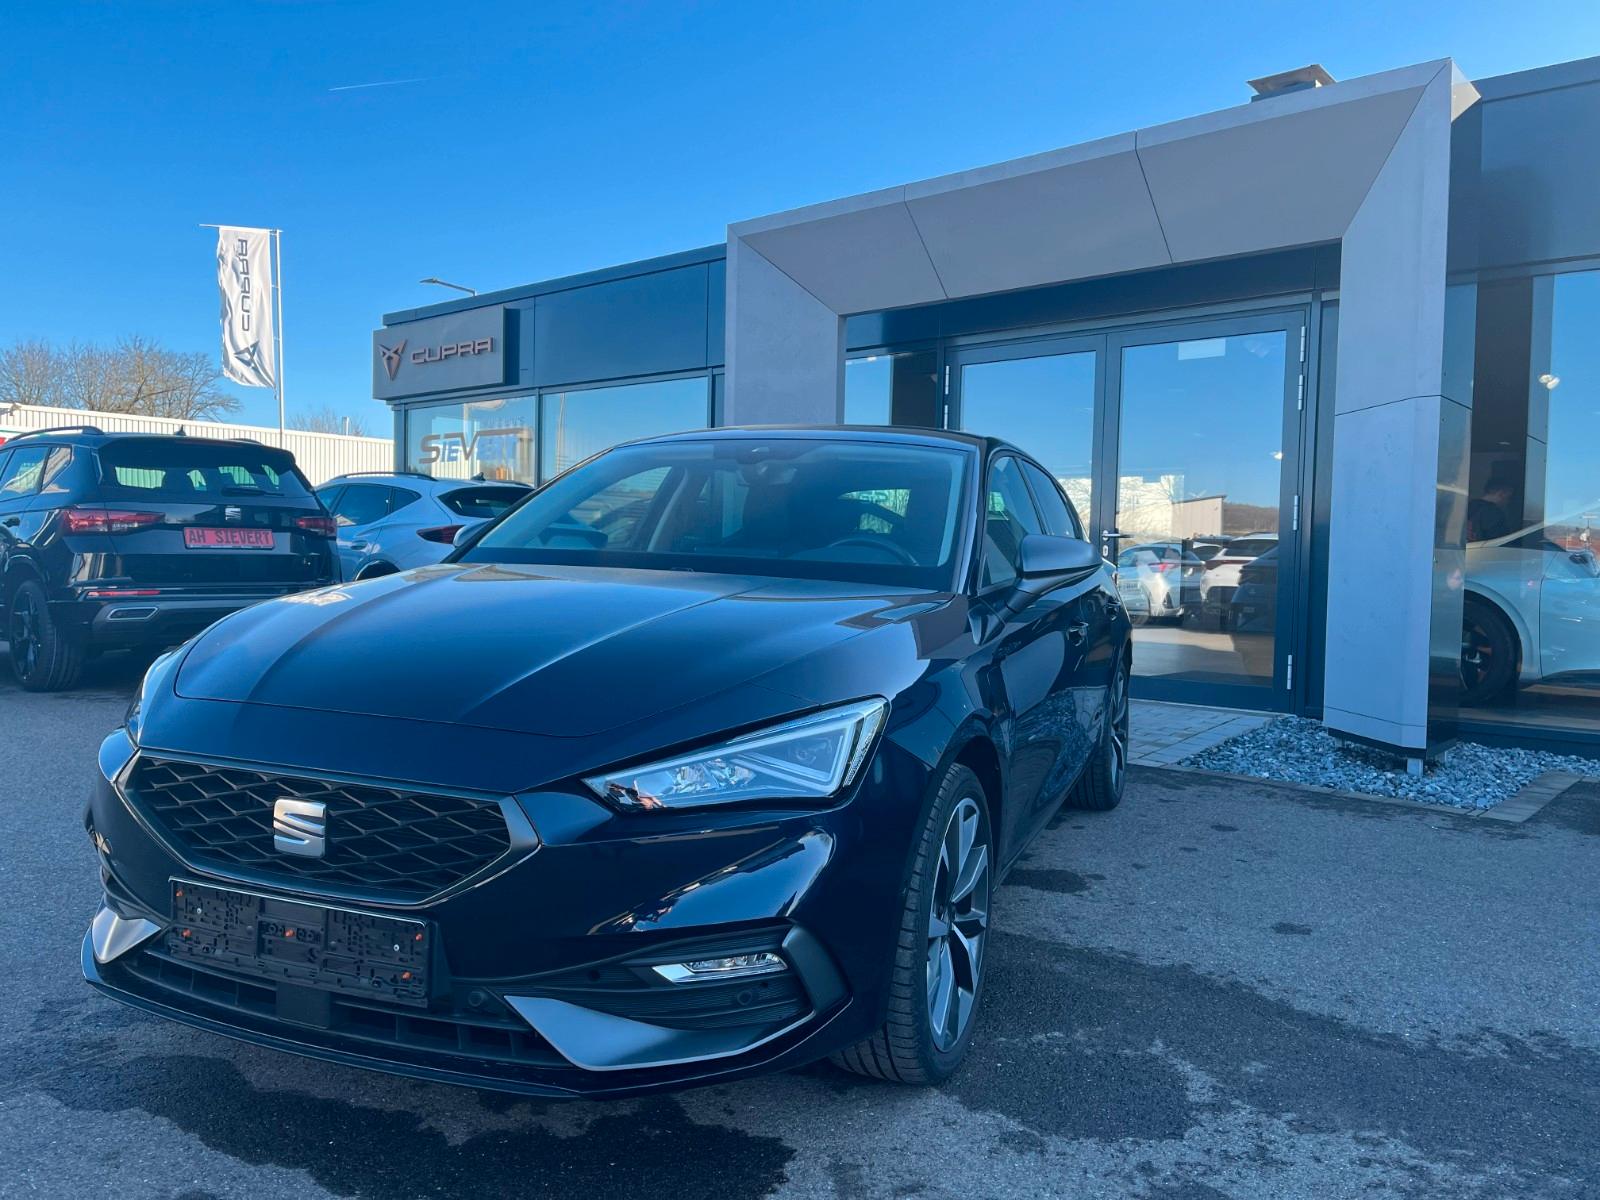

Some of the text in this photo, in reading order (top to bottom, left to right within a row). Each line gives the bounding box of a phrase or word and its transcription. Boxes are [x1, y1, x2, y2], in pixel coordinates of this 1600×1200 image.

[410, 337, 494, 364] CUPRA
[189, 529, 270, 545] AH SIEVERT
